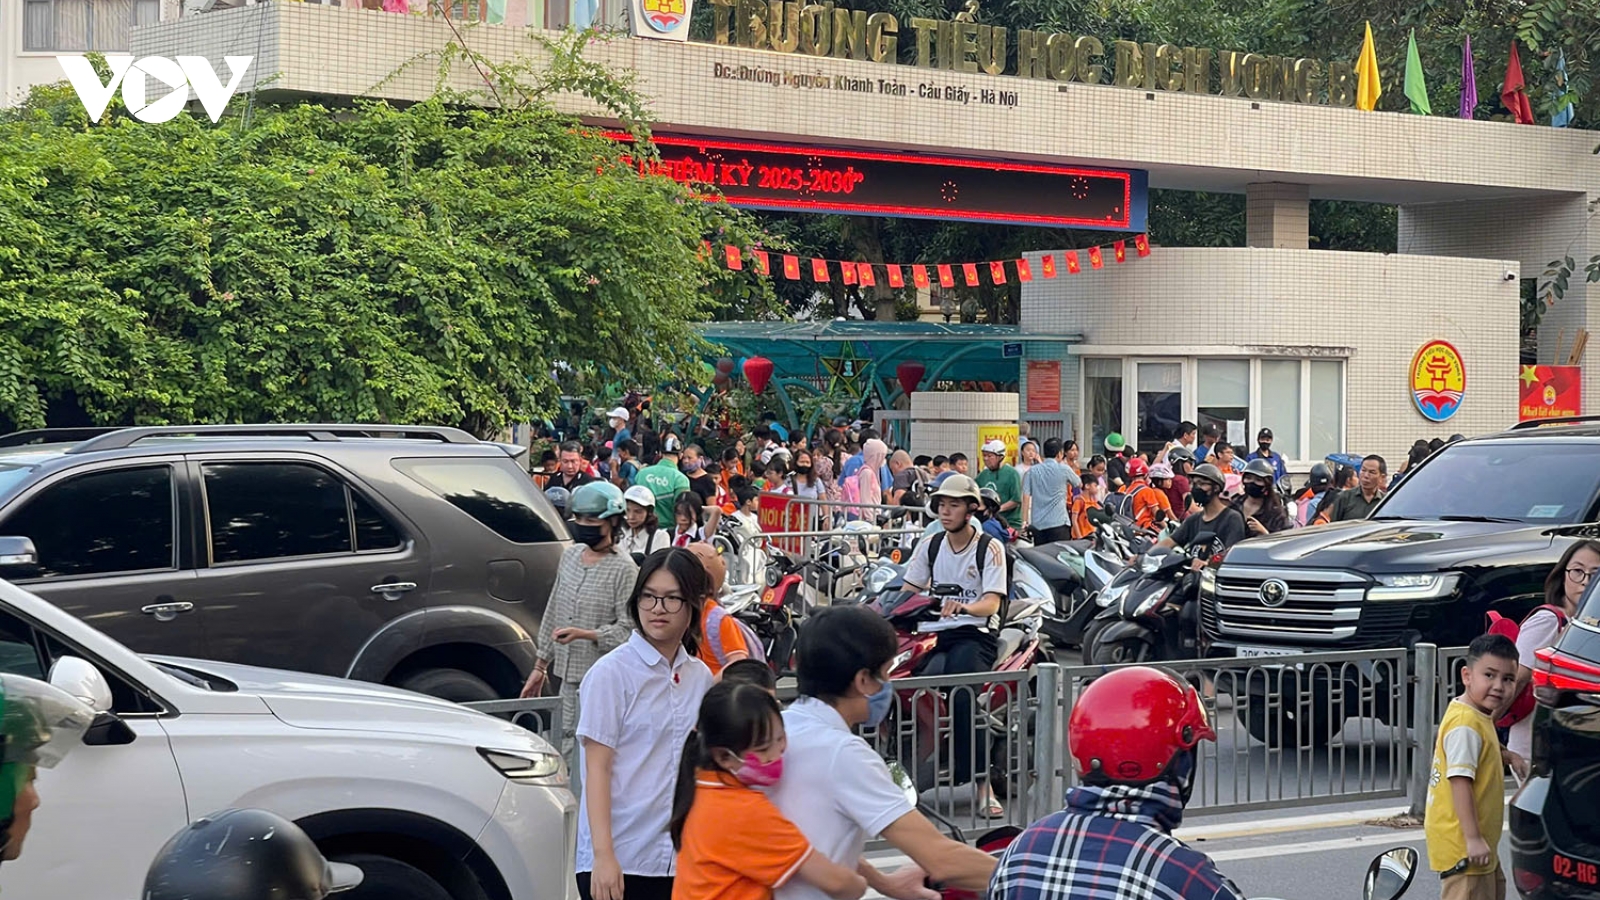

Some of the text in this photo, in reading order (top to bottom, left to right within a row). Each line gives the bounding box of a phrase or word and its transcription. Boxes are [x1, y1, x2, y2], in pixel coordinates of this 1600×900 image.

[911, 0, 1007, 75] TIỂU
[834, 75, 873, 93] Khánh
[945, 85, 970, 105] Giấy
[981, 88, 995, 104] Hà
[1000, 91, 1018, 109] Nội
[719, 159, 754, 187] KỲ
[646, 473, 669, 487] Grab
[1553, 854, 1598, 885] 02-HC
